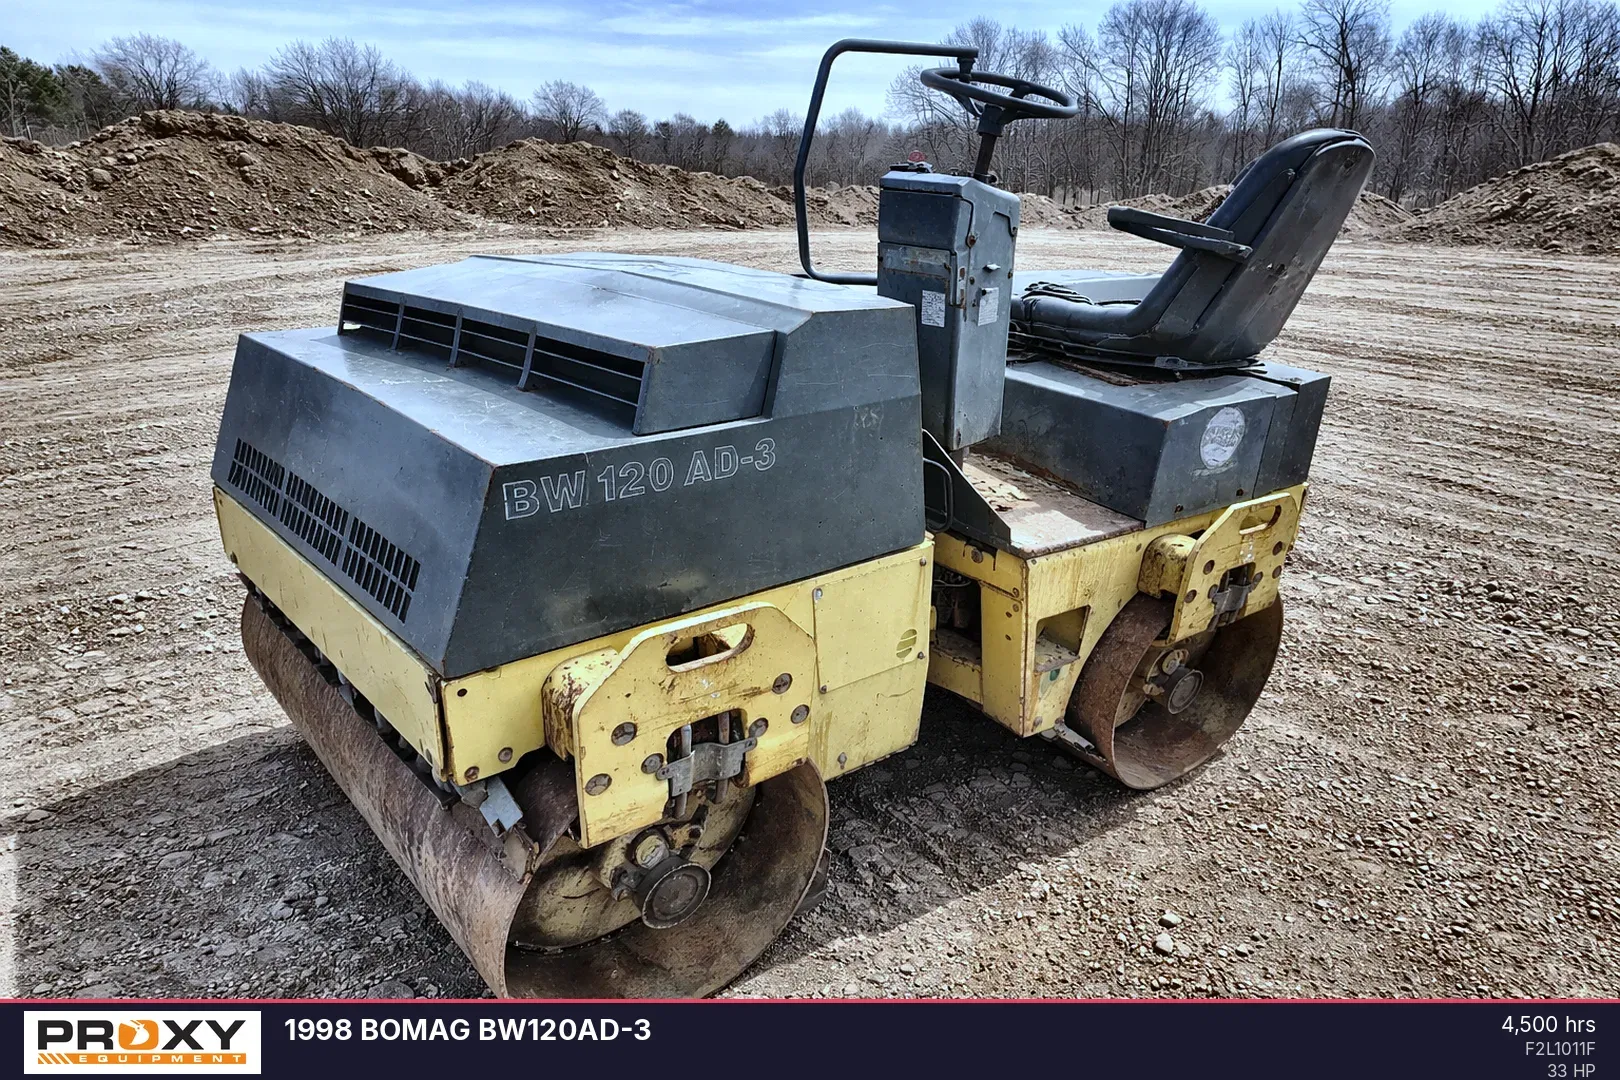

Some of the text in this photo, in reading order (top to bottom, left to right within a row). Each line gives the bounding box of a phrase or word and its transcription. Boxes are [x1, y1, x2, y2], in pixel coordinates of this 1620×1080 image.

[502, 437, 776, 521] BW 120 AD-3
